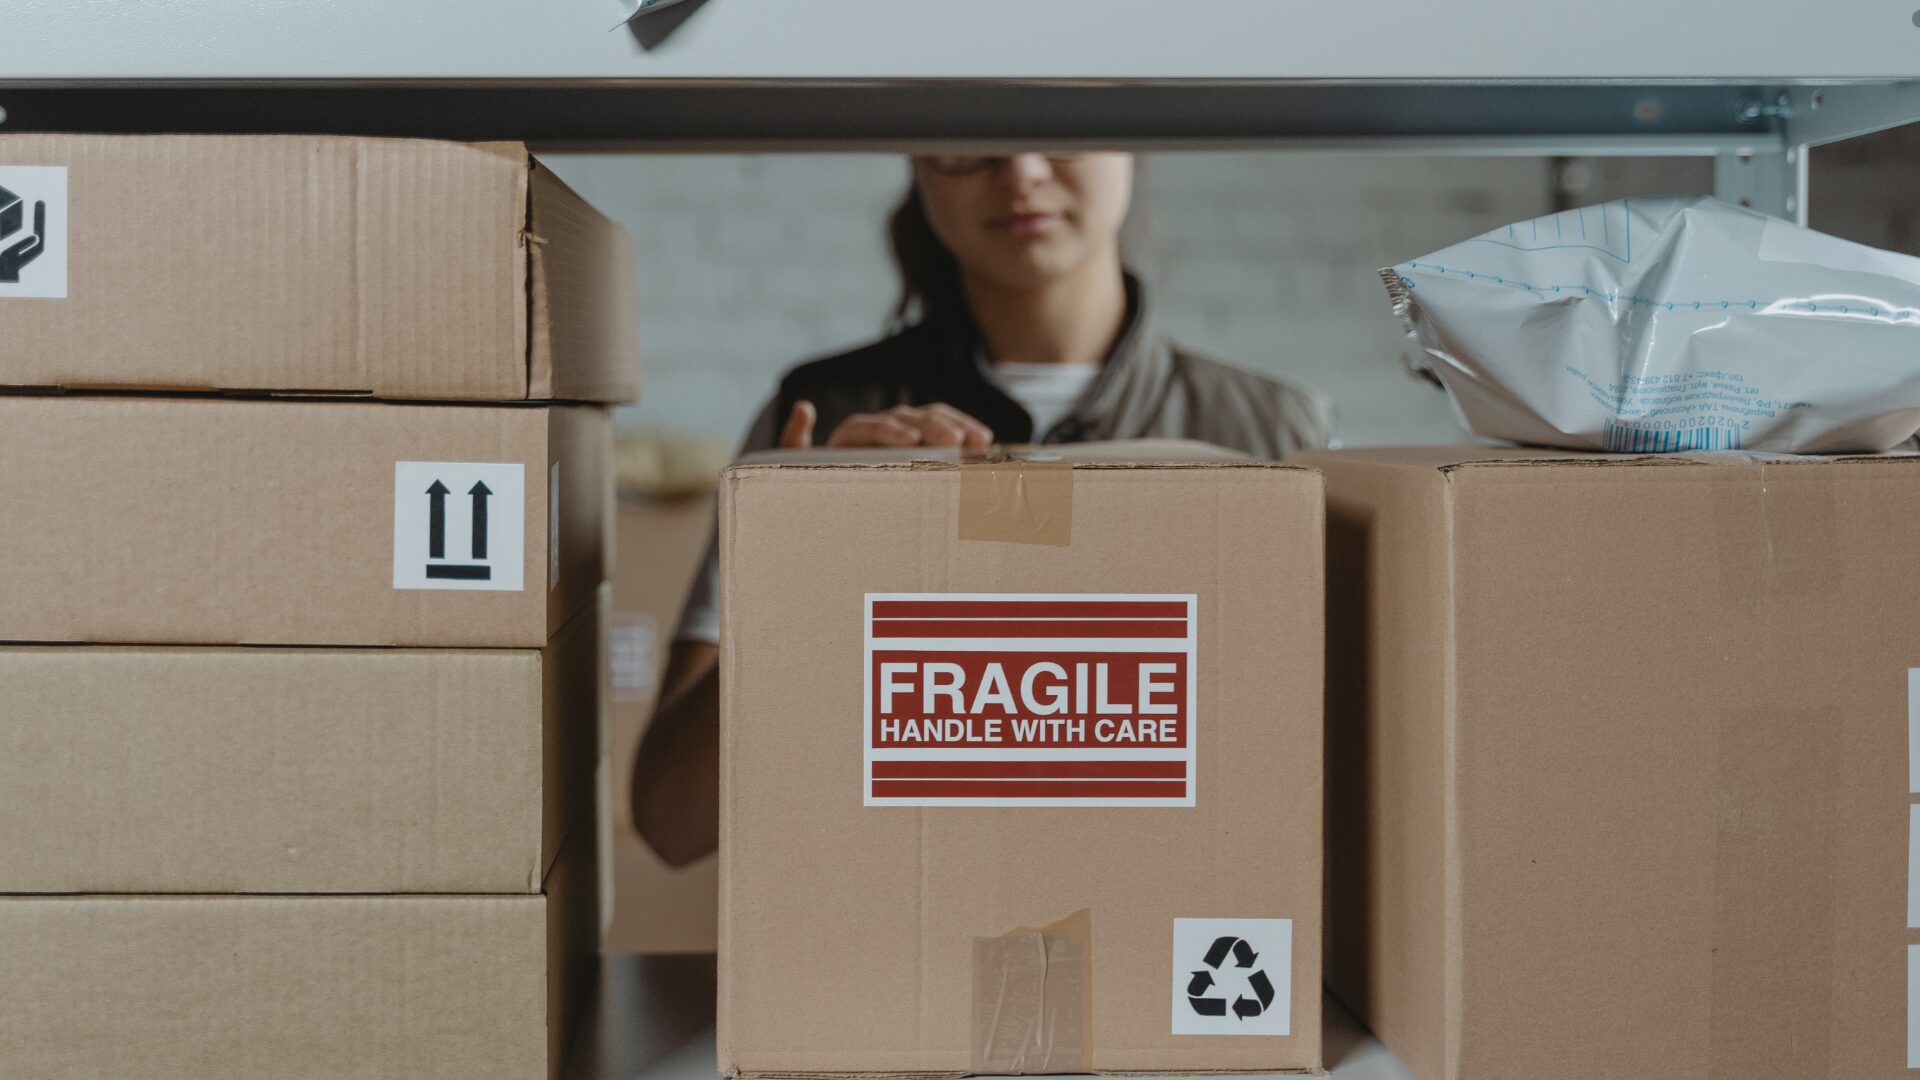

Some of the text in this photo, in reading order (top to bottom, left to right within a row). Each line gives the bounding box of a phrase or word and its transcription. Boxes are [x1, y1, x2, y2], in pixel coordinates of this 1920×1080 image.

[1663, 375, 1681, 384] 812
[1680, 416, 1735, 429] 020200
[1742, 420, 1750, 430] 2
[880, 661, 1178, 715] FRAGILE
[881, 719, 1177, 742] HANDLE WITH CARE
